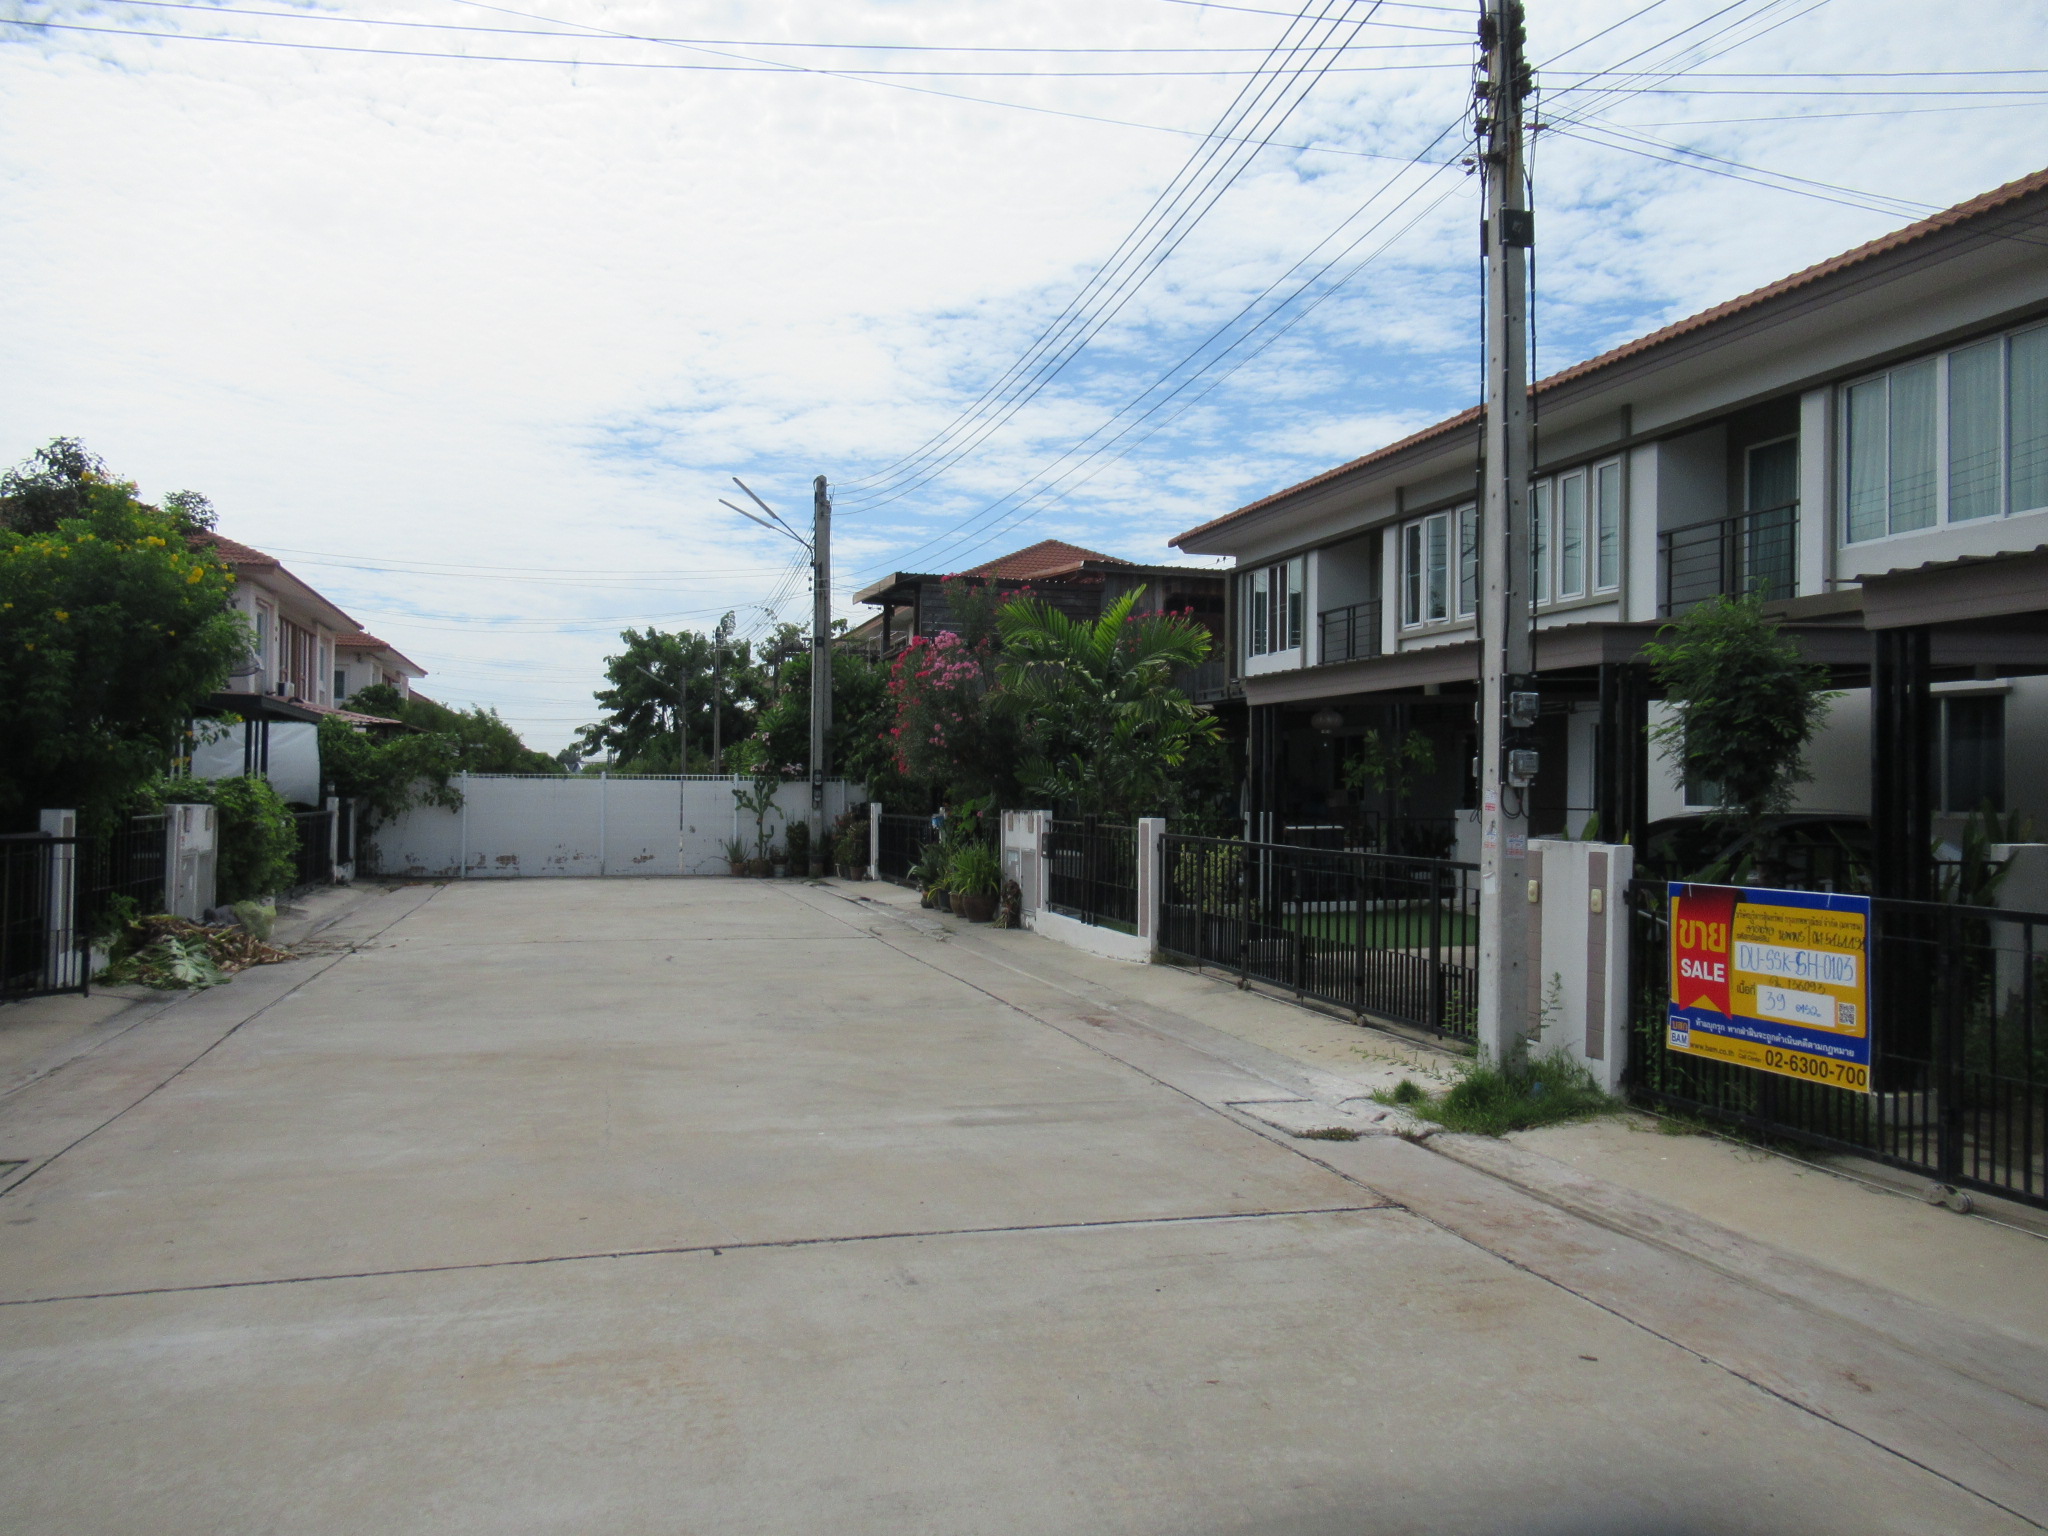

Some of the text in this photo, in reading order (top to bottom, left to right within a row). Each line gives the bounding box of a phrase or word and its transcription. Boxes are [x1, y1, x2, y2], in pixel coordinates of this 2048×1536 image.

[1680, 919, 1726, 953] ขาย
[1681, 958, 1725, 983] SALE
[1736, 980, 1756, 995] เนื้อที่
[1765, 991, 1786, 1011] 39
[1671, 1032, 1688, 1044] BAM
[1765, 1049, 1866, 1087] 02-6300-700
